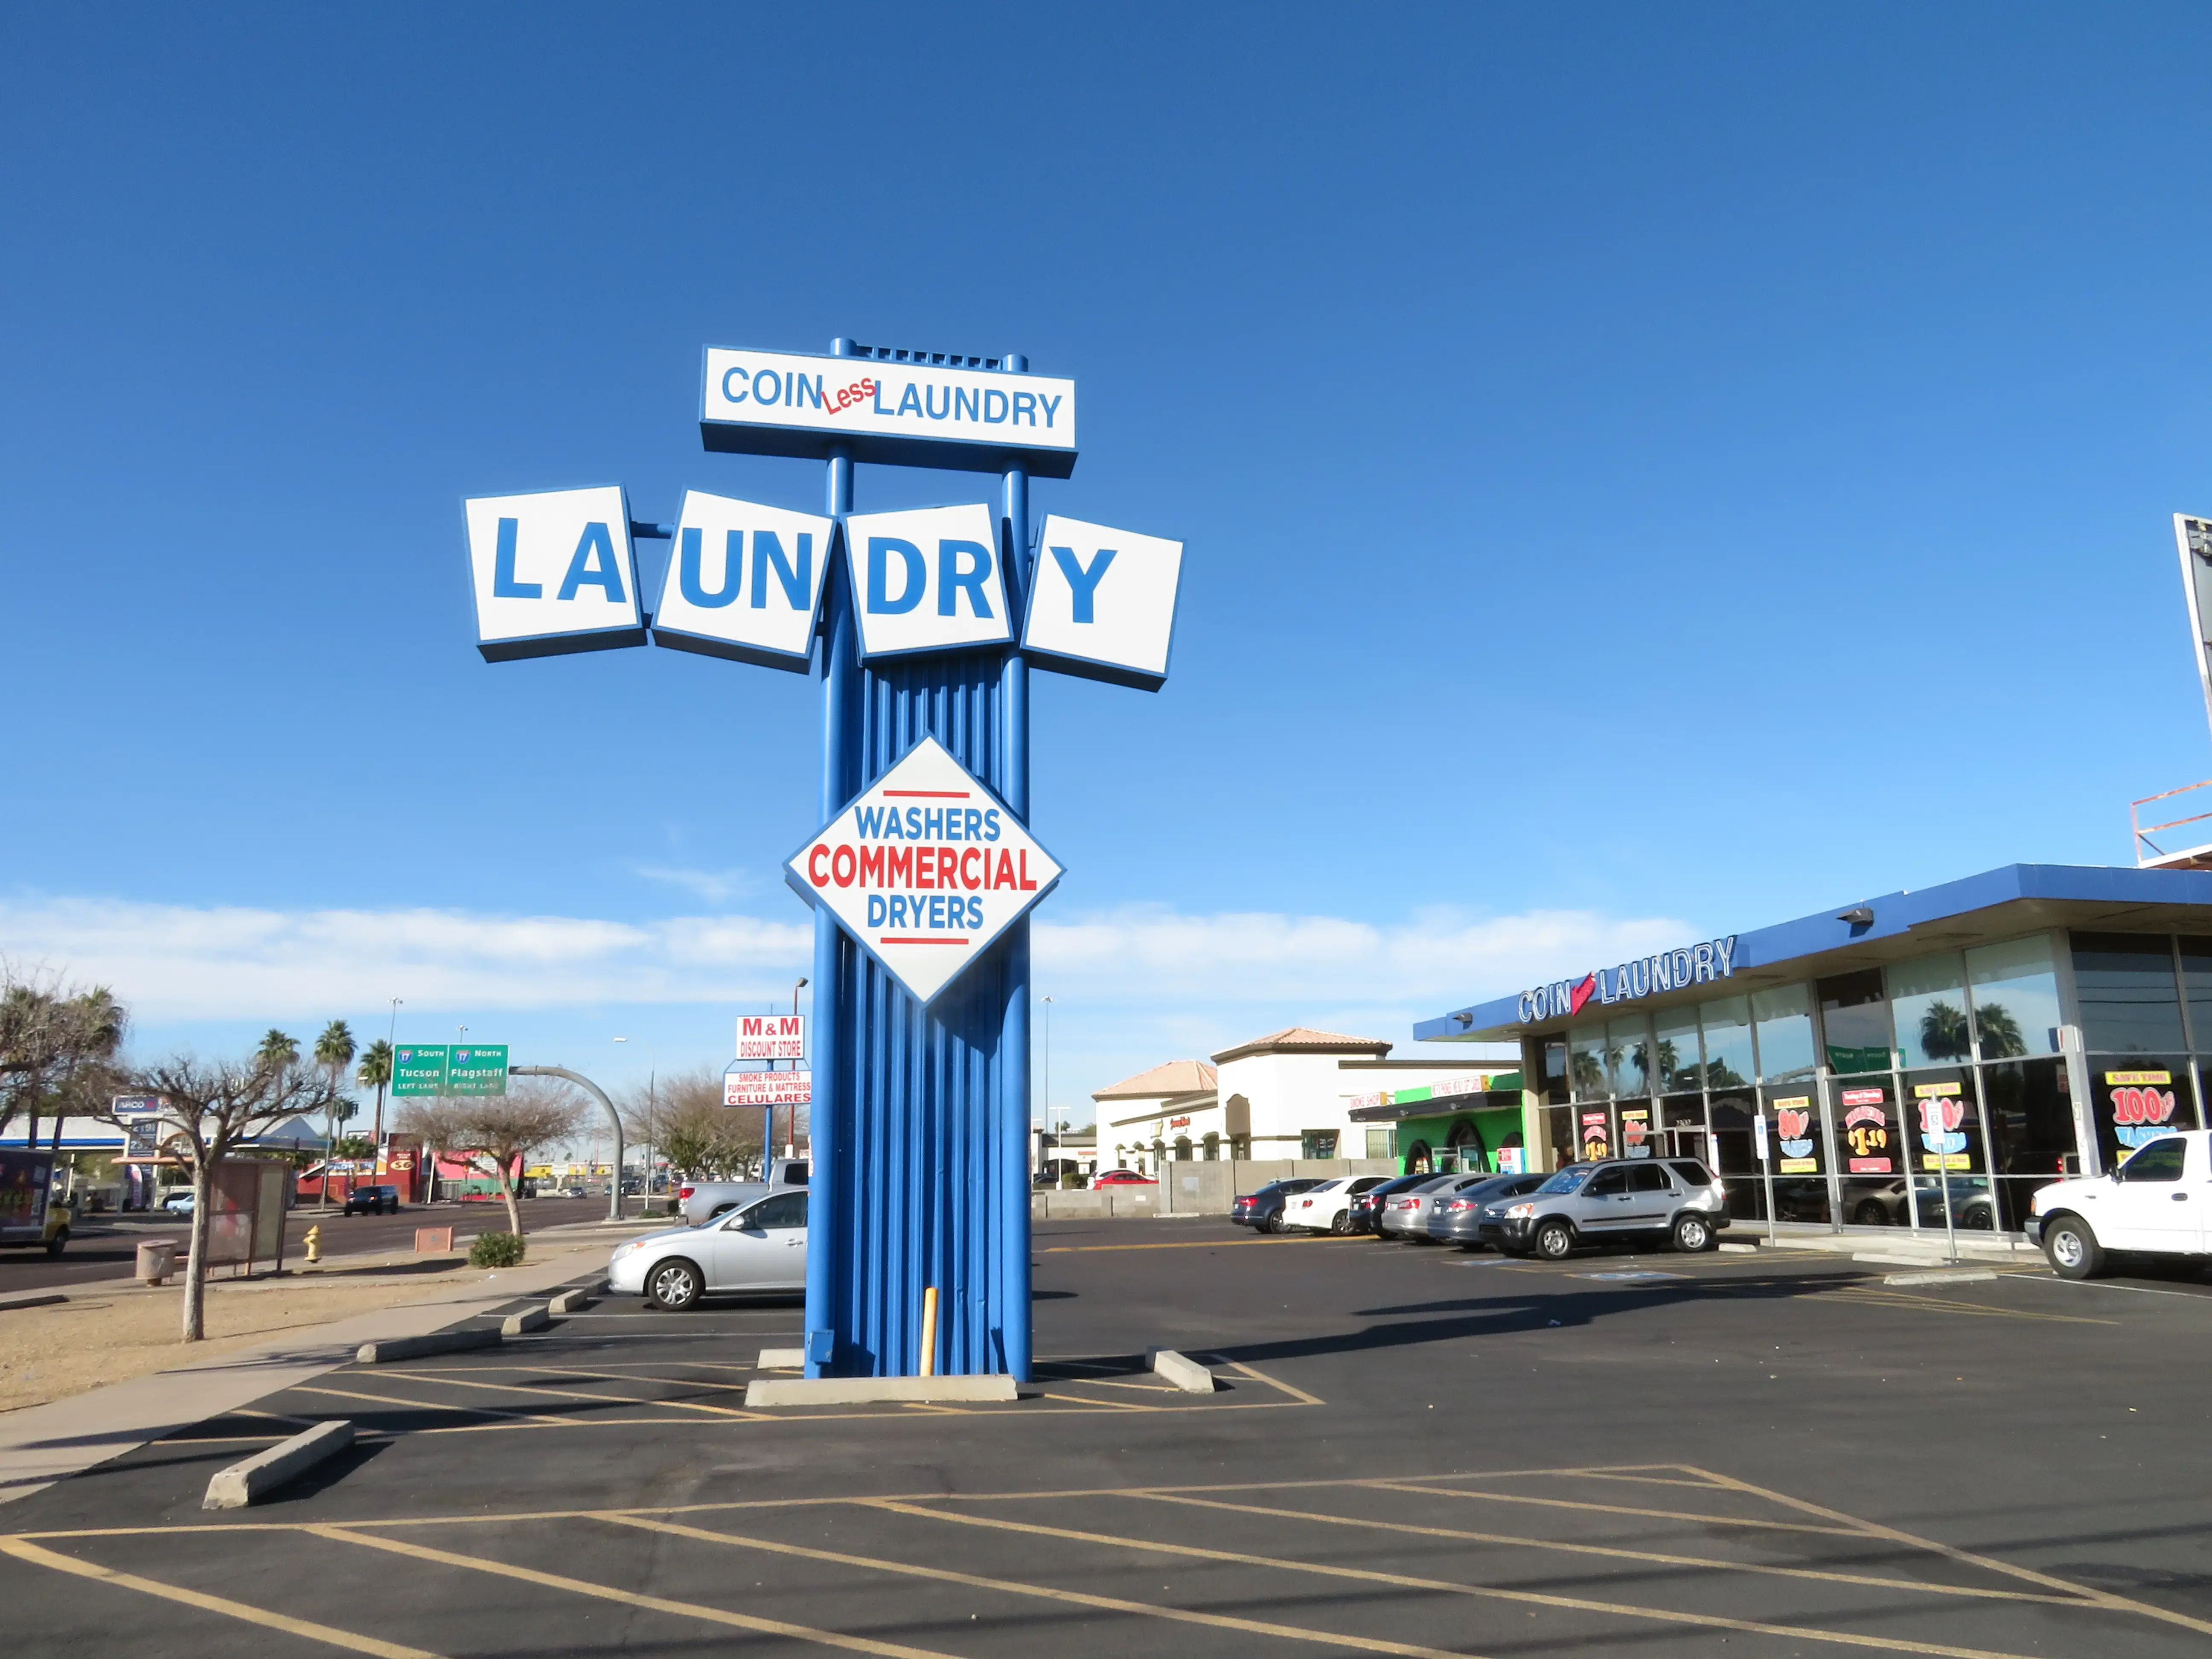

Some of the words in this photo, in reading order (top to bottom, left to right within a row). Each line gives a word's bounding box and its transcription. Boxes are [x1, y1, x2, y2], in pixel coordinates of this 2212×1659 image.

[722, 367, 822, 408] COIN
[820, 377, 876, 415] Less
[873, 380, 1062, 428] LAUNDRY
[854, 806, 1001, 841] WASHERS
[808, 844, 1037, 891] COMMERCIAL
[868, 894, 983, 929] DRYERS
[1518, 980, 1572, 1024] COIN
[1599, 935, 1738, 1005] LAUNDRY
[740, 1041, 776, 1057] DISCOUNT
[778, 1040, 800, 1056] STORE
[458, 1054, 467, 1062] 17
[399, 1068, 440, 1077] Tucson
[451, 1068, 504, 1079] Flagstaff
[739, 1073, 763, 1083] SMOKE
[765, 1072, 800, 1081] PRODUCTS
[728, 1083, 766, 1093] FURNITURE
[768, 1083, 774, 1092] &
[775, 1082, 811, 1092] MATTRESS
[728, 1093, 811, 1104] CELULARES
[1350, 1097, 1365, 1109] SMOKE
[1367, 1094, 1379, 1106] SHOP
[2112, 1089, 2162, 1122] 100
